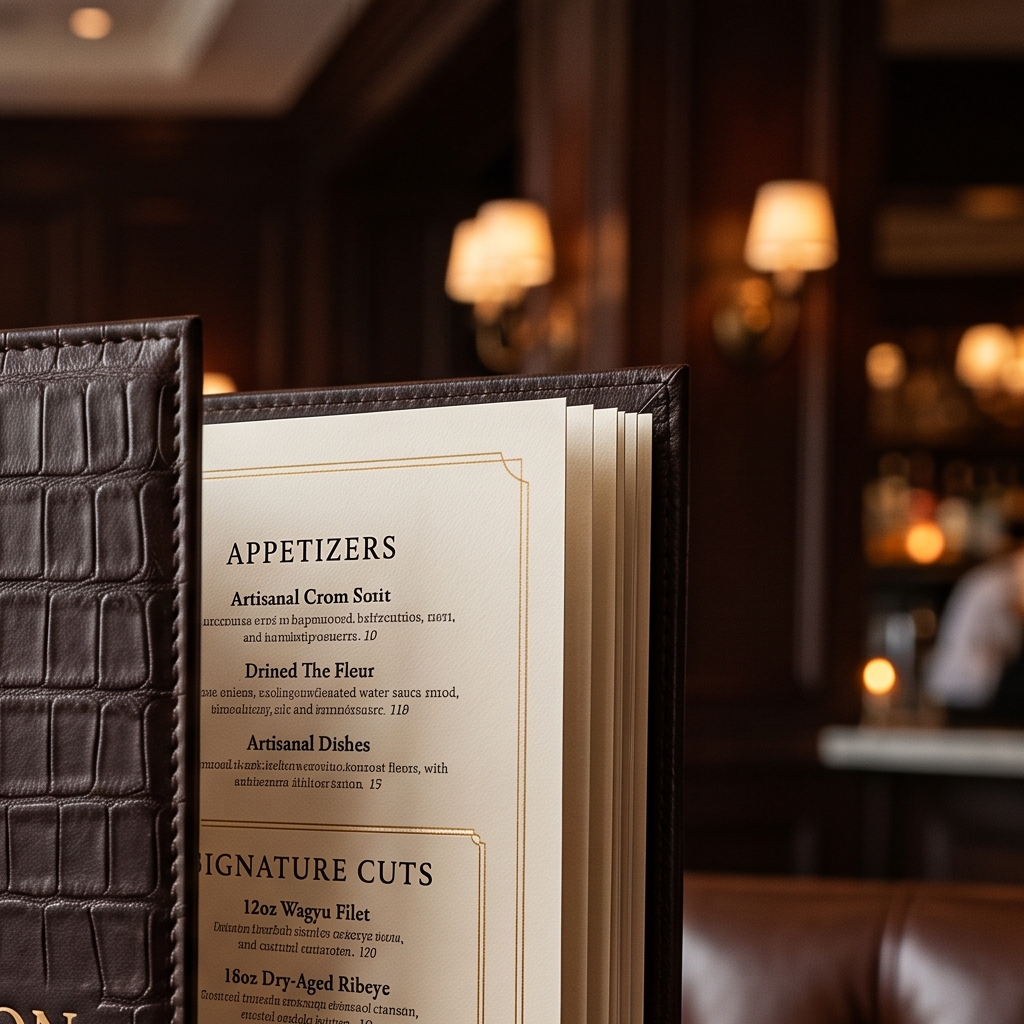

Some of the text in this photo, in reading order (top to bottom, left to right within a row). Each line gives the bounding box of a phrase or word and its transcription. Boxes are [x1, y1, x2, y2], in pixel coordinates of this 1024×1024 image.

[226, 535, 396, 565] APPETIZERS
[230, 588, 300, 607] Artisanal
[303, 588, 349, 605] Crom
[243, 632, 262, 643] and
[245, 662, 374, 679] Drined The Fleur
[359, 687, 390, 698] water
[293, 703, 313, 715] and
[247, 734, 371, 752] Artisanal Dishes
[424, 762, 448, 774] with
[198, 852, 433, 886] IGNATURE CUTS
[244, 899, 370, 924] 12oz Wagyu Filet
[238, 940, 257, 950] and
[359, 946, 377, 958] 120
[225, 968, 390, 1000] 18oz Dry-Aged Ribeye
